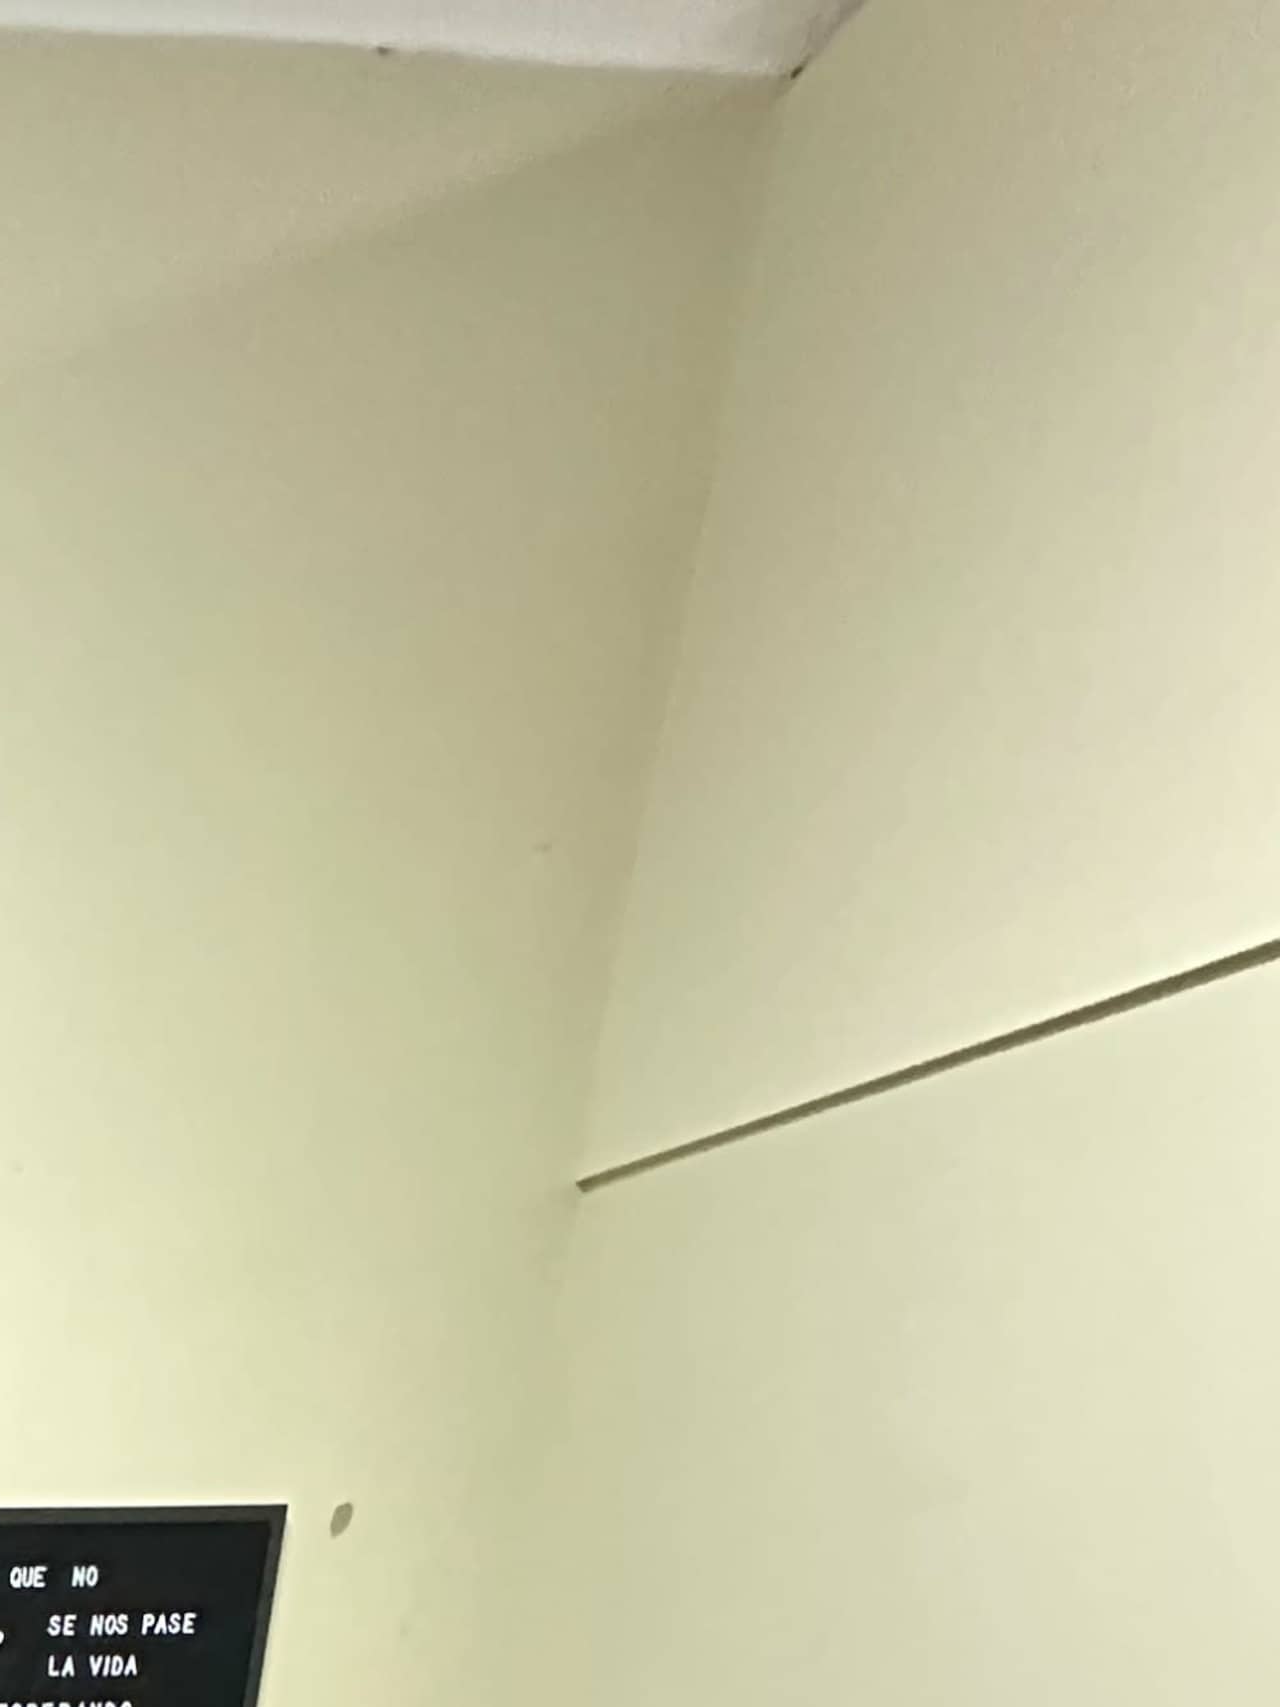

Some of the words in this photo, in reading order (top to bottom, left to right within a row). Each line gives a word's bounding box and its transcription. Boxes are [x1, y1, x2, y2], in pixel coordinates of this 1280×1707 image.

[9, 1566, 47, 1588] QUE
[71, 1565, 99, 1587] NO
[47, 1614, 77, 1636] SE
[90, 1614, 129, 1636] NOS
[141, 1612, 197, 1635] PASE
[47, 1655, 75, 1677] LA
[89, 1654, 138, 1677] VIDA
